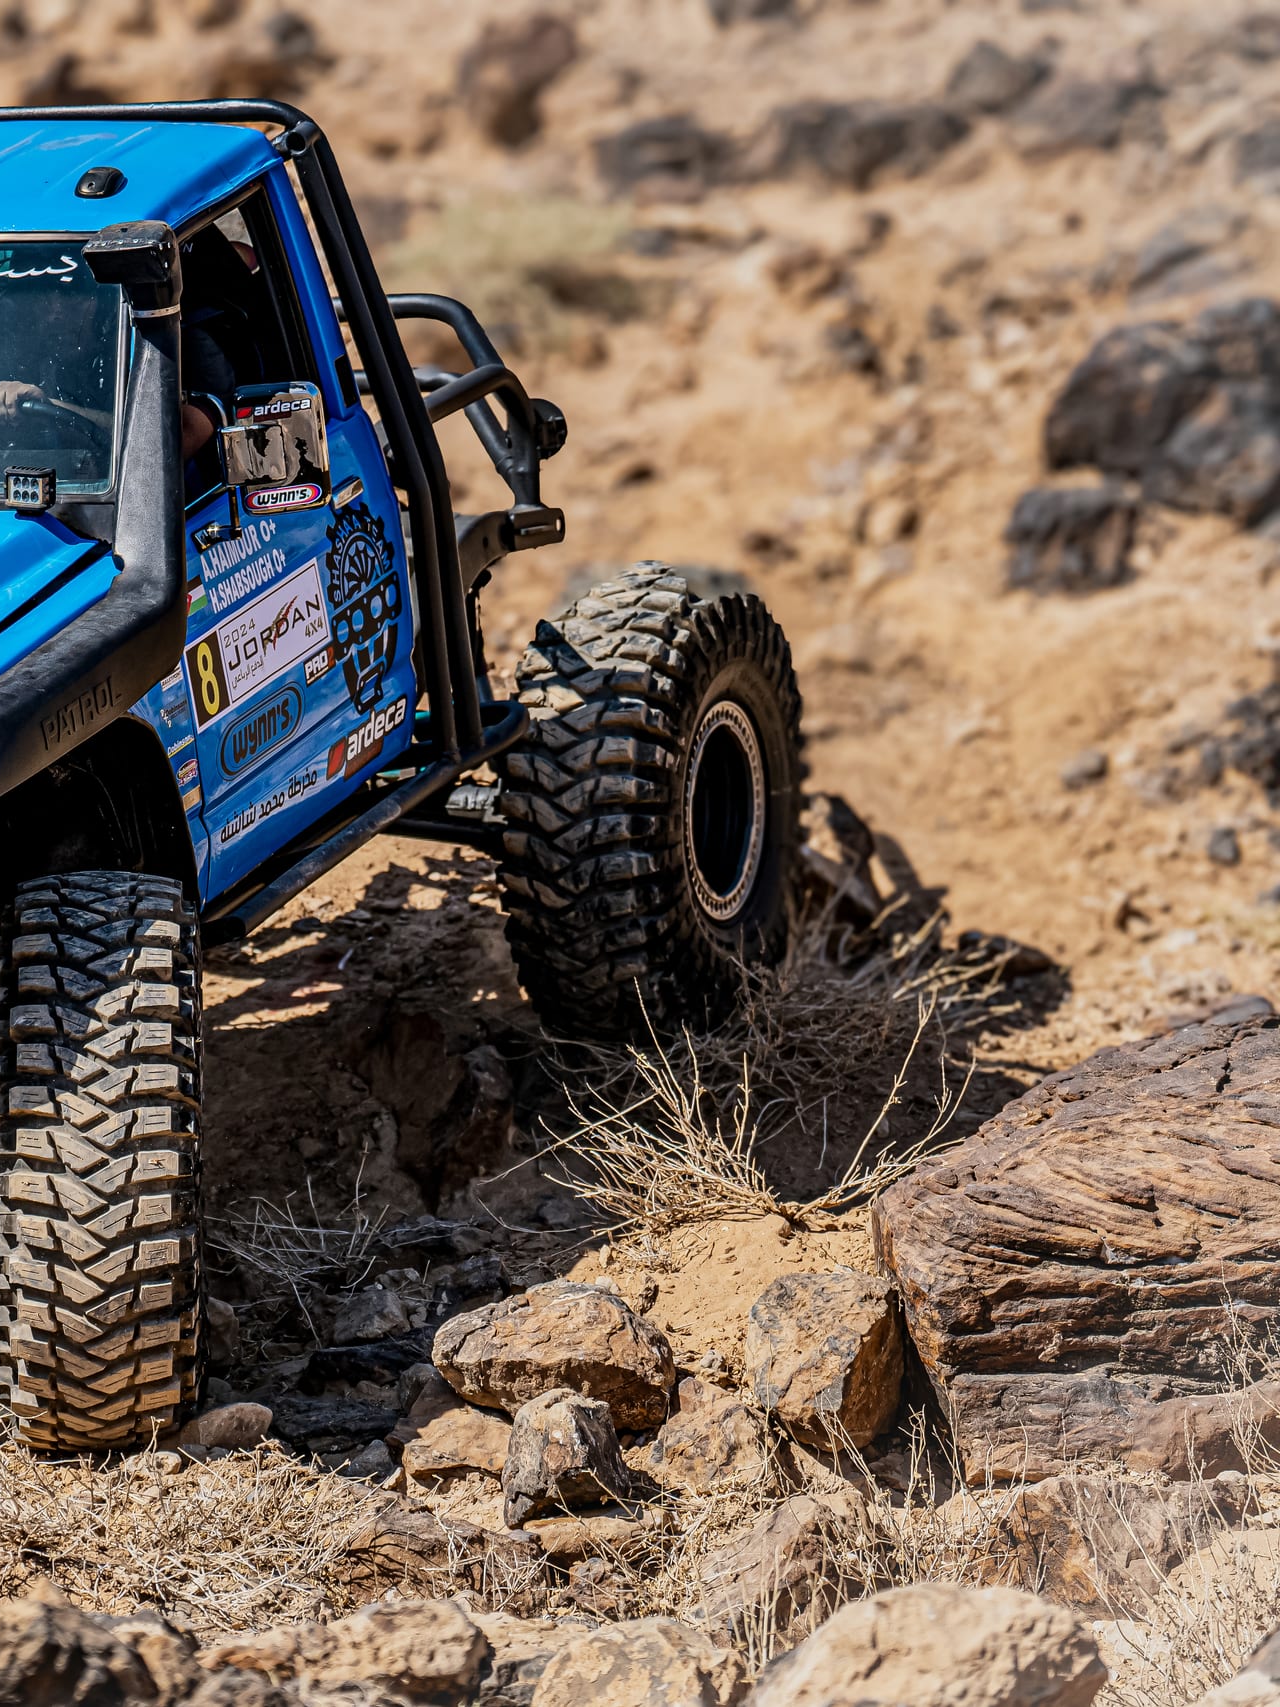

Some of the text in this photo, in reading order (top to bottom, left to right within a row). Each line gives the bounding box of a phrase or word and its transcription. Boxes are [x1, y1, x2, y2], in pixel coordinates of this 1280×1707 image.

[254, 398, 311, 416] ardeca
[200, 524, 261, 582] A.HAIMOUR
[209, 552, 275, 614] H.SHABSOUGH
[223, 618, 256, 648] 2024
[228, 594, 321, 671] JORDAN
[196, 642, 220, 717] 8
[304, 647, 335, 680] PRO2
[40, 676, 122, 751] PATROL
[347, 698, 407, 761] ardeca
[259, 791, 285, 819] محمد
